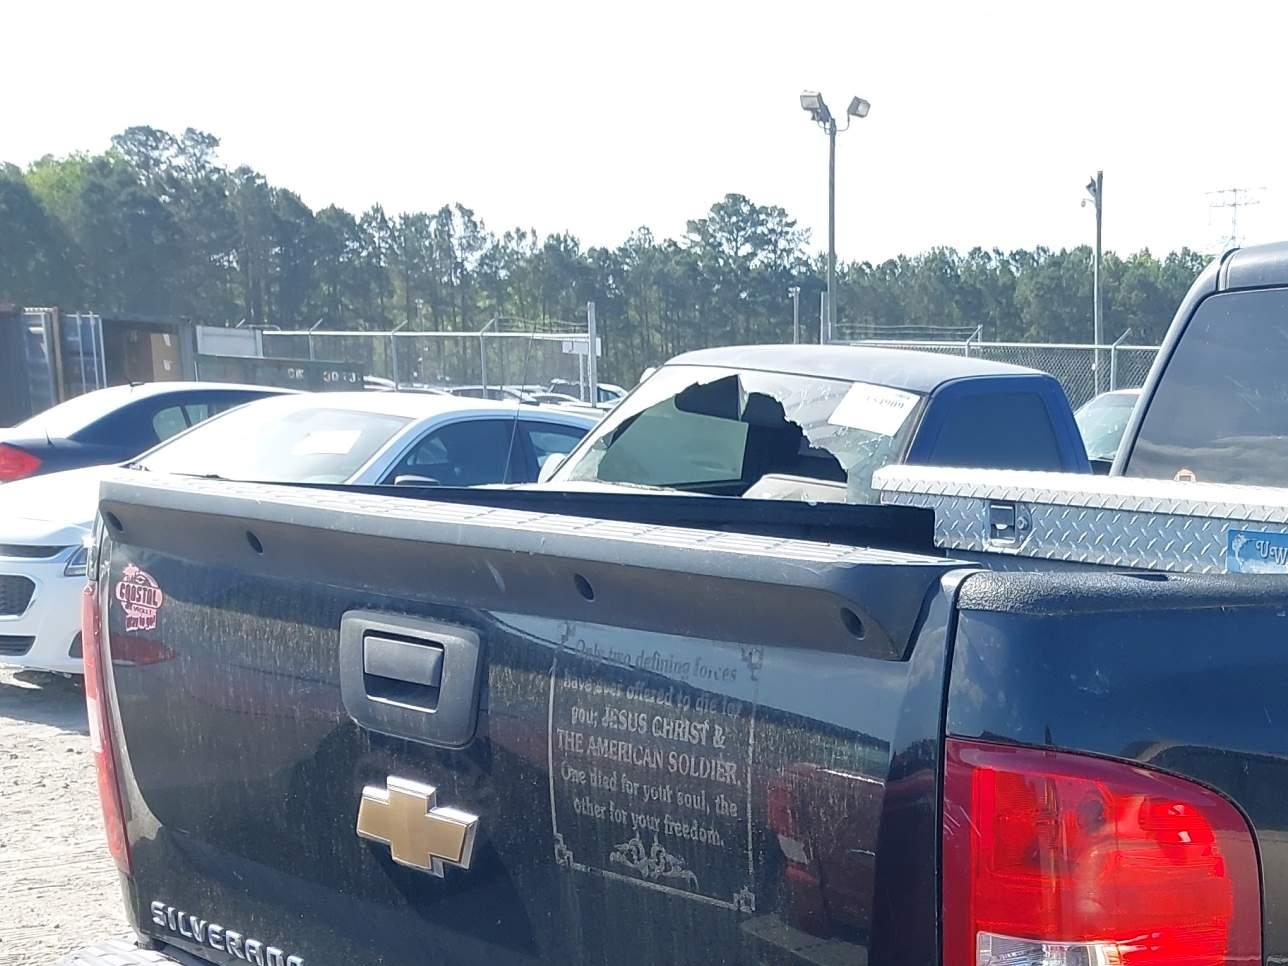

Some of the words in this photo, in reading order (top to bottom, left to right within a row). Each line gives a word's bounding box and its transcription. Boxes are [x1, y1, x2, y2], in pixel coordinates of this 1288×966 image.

[119, 582, 159, 607] COASTAL
[635, 649, 690, 681] defining
[694, 656, 737, 682] forces
[626, 681, 673, 706] offered
[602, 705, 648, 734] JESUS
[651, 715, 710, 746] CHRIST
[713, 723, 726, 749] &
[556, 728, 585, 753] THE
[586, 735, 664, 769] AMERICAN
[667, 751, 741, 786] SOLDIER.
[561, 760, 587, 784] One
[590, 767, 618, 792] died
[621, 773, 640, 796] for
[643, 783, 673, 803] your
[676, 790, 709, 817] soul,
[714, 794, 738, 817] the
[573, 796, 606, 818] other
[609, 800, 628, 825] for
[631, 811, 661, 832] your
[663, 813, 725, 847] freedom.
